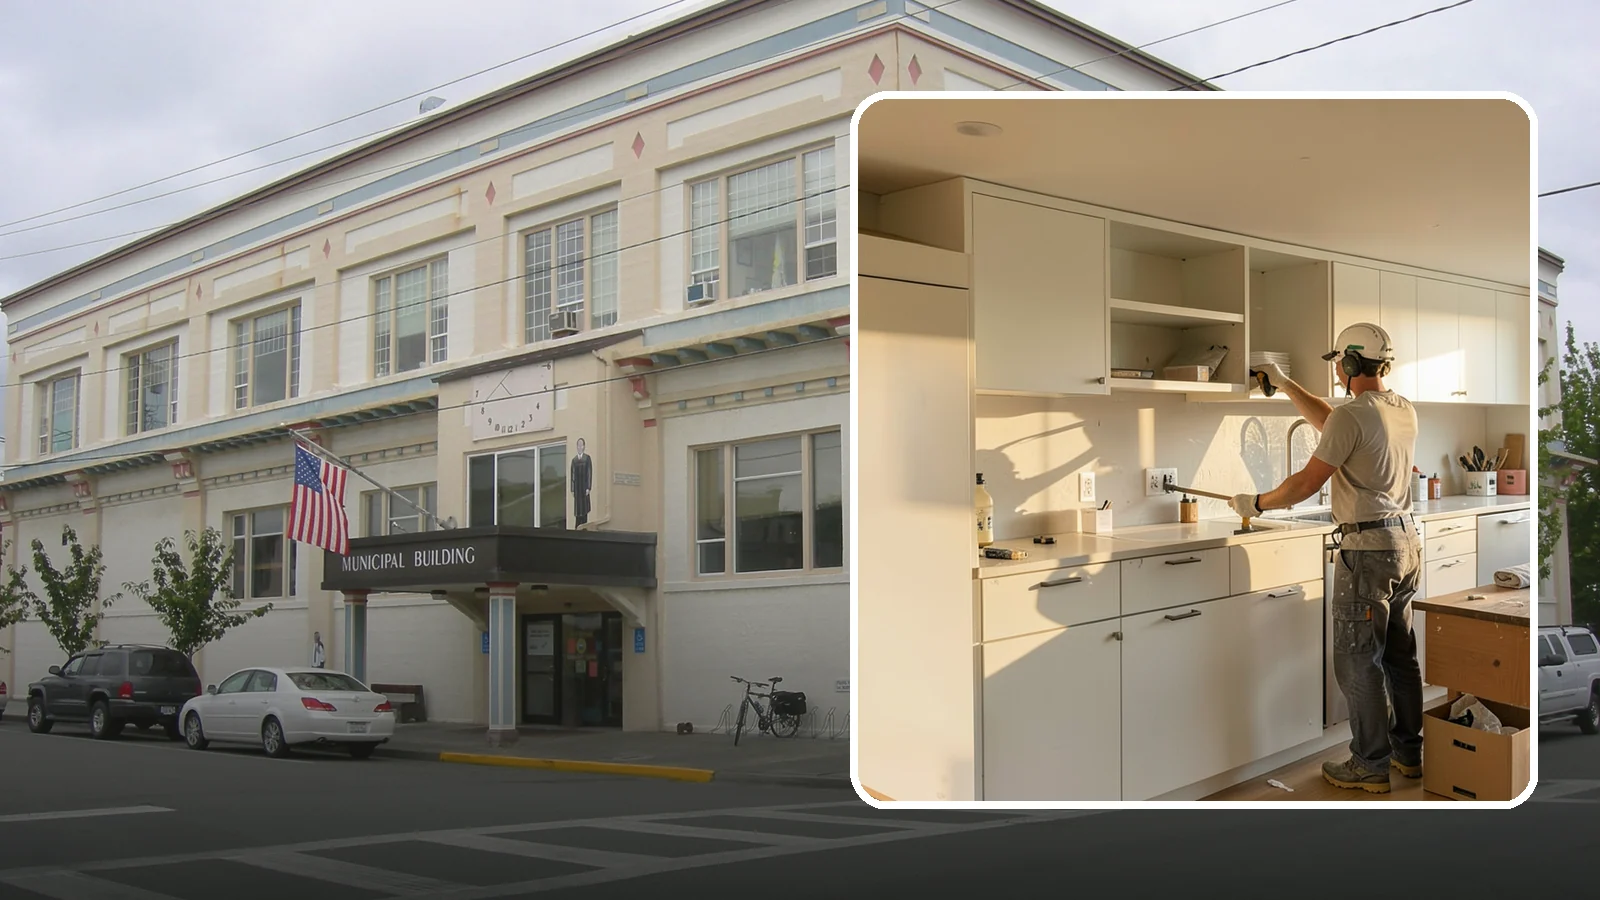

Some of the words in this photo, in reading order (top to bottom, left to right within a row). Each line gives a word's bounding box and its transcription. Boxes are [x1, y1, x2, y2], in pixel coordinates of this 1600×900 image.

[488, 418, 492, 426] 9
[529, 414, 533, 422] 3
[342, 552, 405, 571] MUNICIPAL
[414, 546, 475, 566] BUILDING
